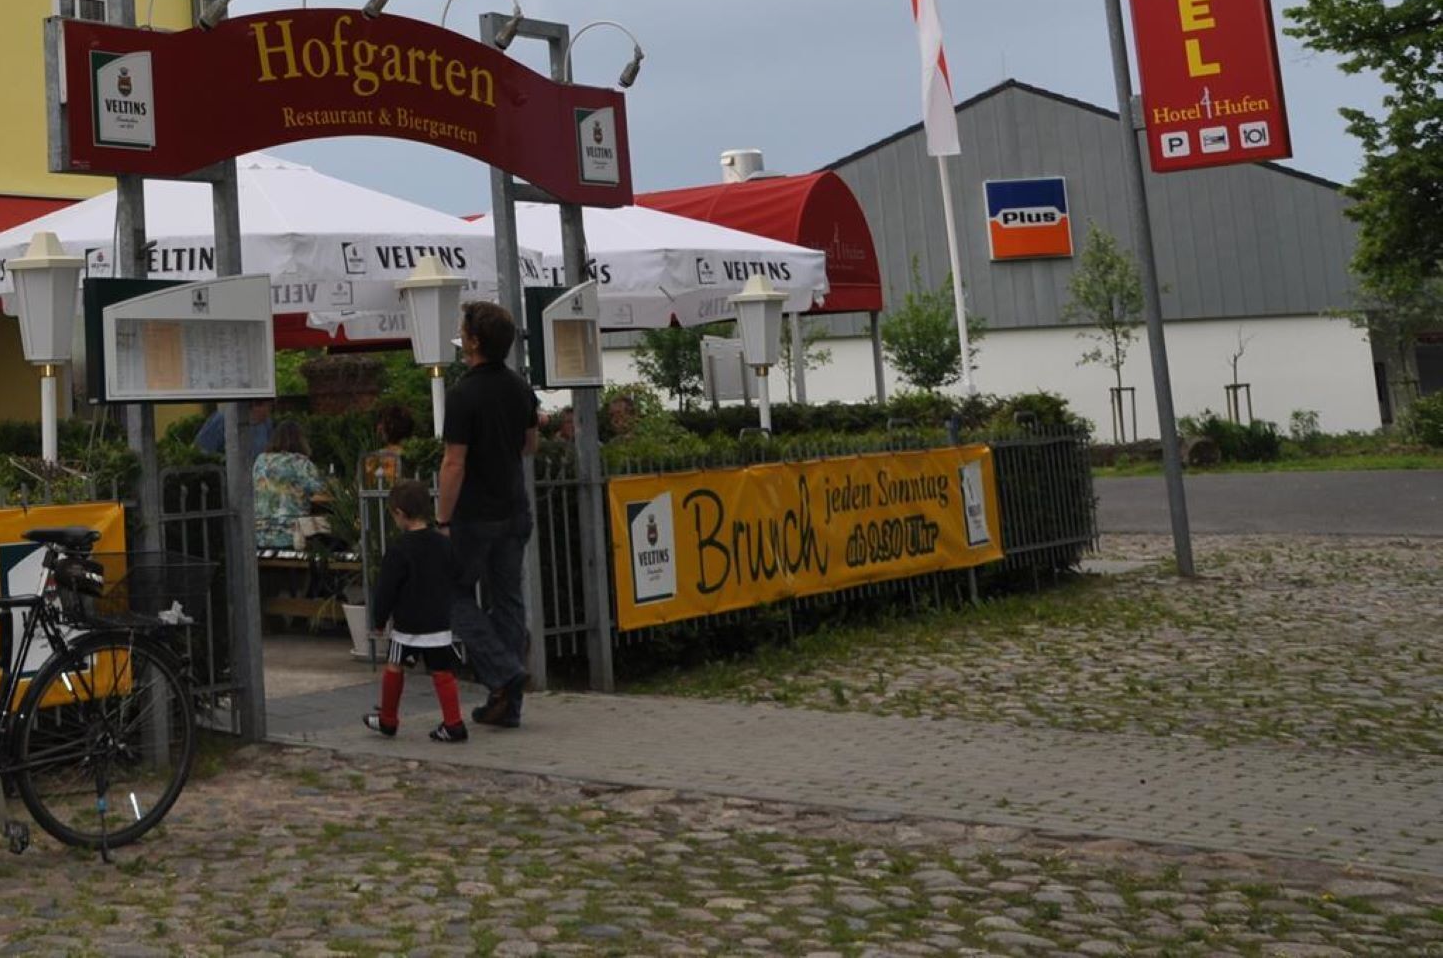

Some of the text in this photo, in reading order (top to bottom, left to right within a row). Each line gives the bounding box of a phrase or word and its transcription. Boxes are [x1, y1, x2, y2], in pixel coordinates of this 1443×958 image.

[250, 16, 496, 108] Hofgarten
[105, 98, 147, 116] VELTINS
[1153, 103, 1201, 124] Hotel
[1214, 95, 1269, 116] Hufen
[282, 106, 478, 145] Restaurant & Biergarten
[585, 145, 614, 160] VELTINS
[1168, 137, 1183, 153] P
[1002, 210, 1056, 225] Plus
[147, 246, 215, 273] ELTIN
[824, 470, 949, 525] jeden Sonntag
[904, 512, 940, 556] Uhr
[637, 548, 670, 567] VELTINS
